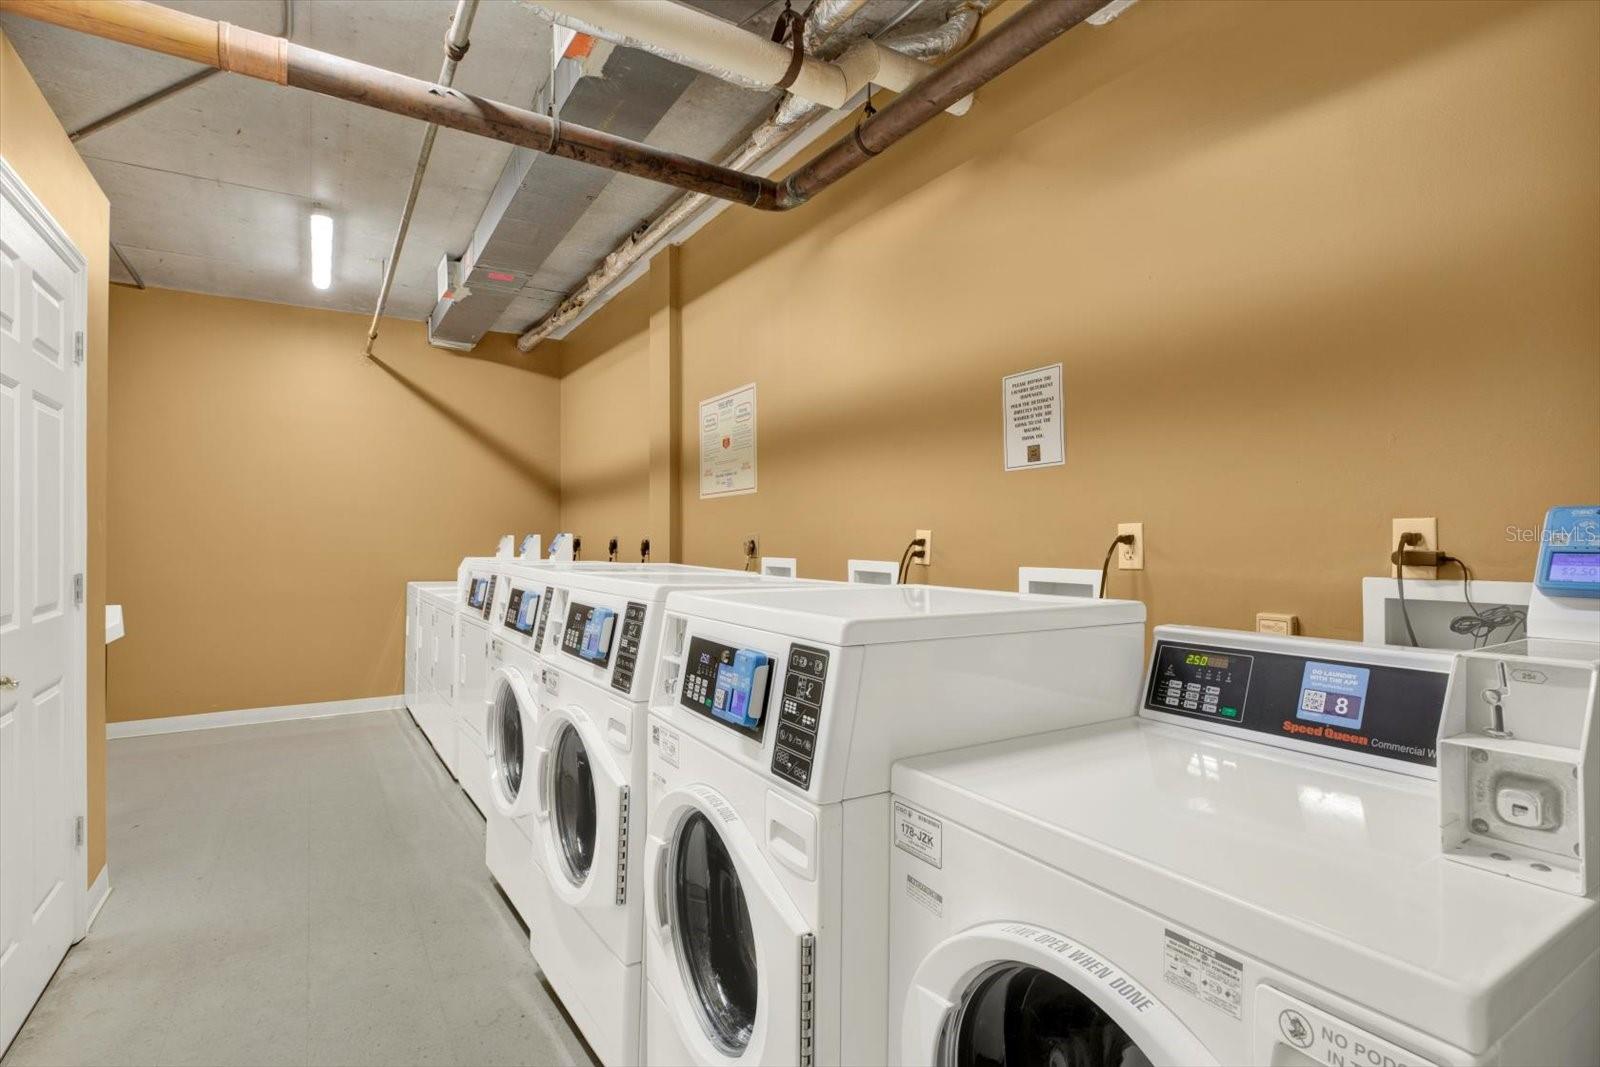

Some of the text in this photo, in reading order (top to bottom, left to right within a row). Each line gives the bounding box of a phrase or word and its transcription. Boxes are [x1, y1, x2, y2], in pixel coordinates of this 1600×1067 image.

[1029, 381, 1053, 391] DETERGENT
[1030, 396, 1054, 405] DETERGENT
[1323, 670, 1358, 679] LAUNDRY
[1334, 697, 1349, 714] 8
[1282, 720, 1323, 736] Speed
[1324, 727, 1368, 745] Queen
[1370, 738, 1425, 756] Commercial
[901, 822, 934, 848] 178-JZK
[1001, 925, 1039, 938] LEAVE
[1034, 934, 1072, 953] OPEN
[1068, 949, 1114, 980] WHEN
[1109, 977, 1154, 1012] DONE
[1322, 1026, 1409, 1067] NO POD
[1328, 1050, 1344, 1067] IN
